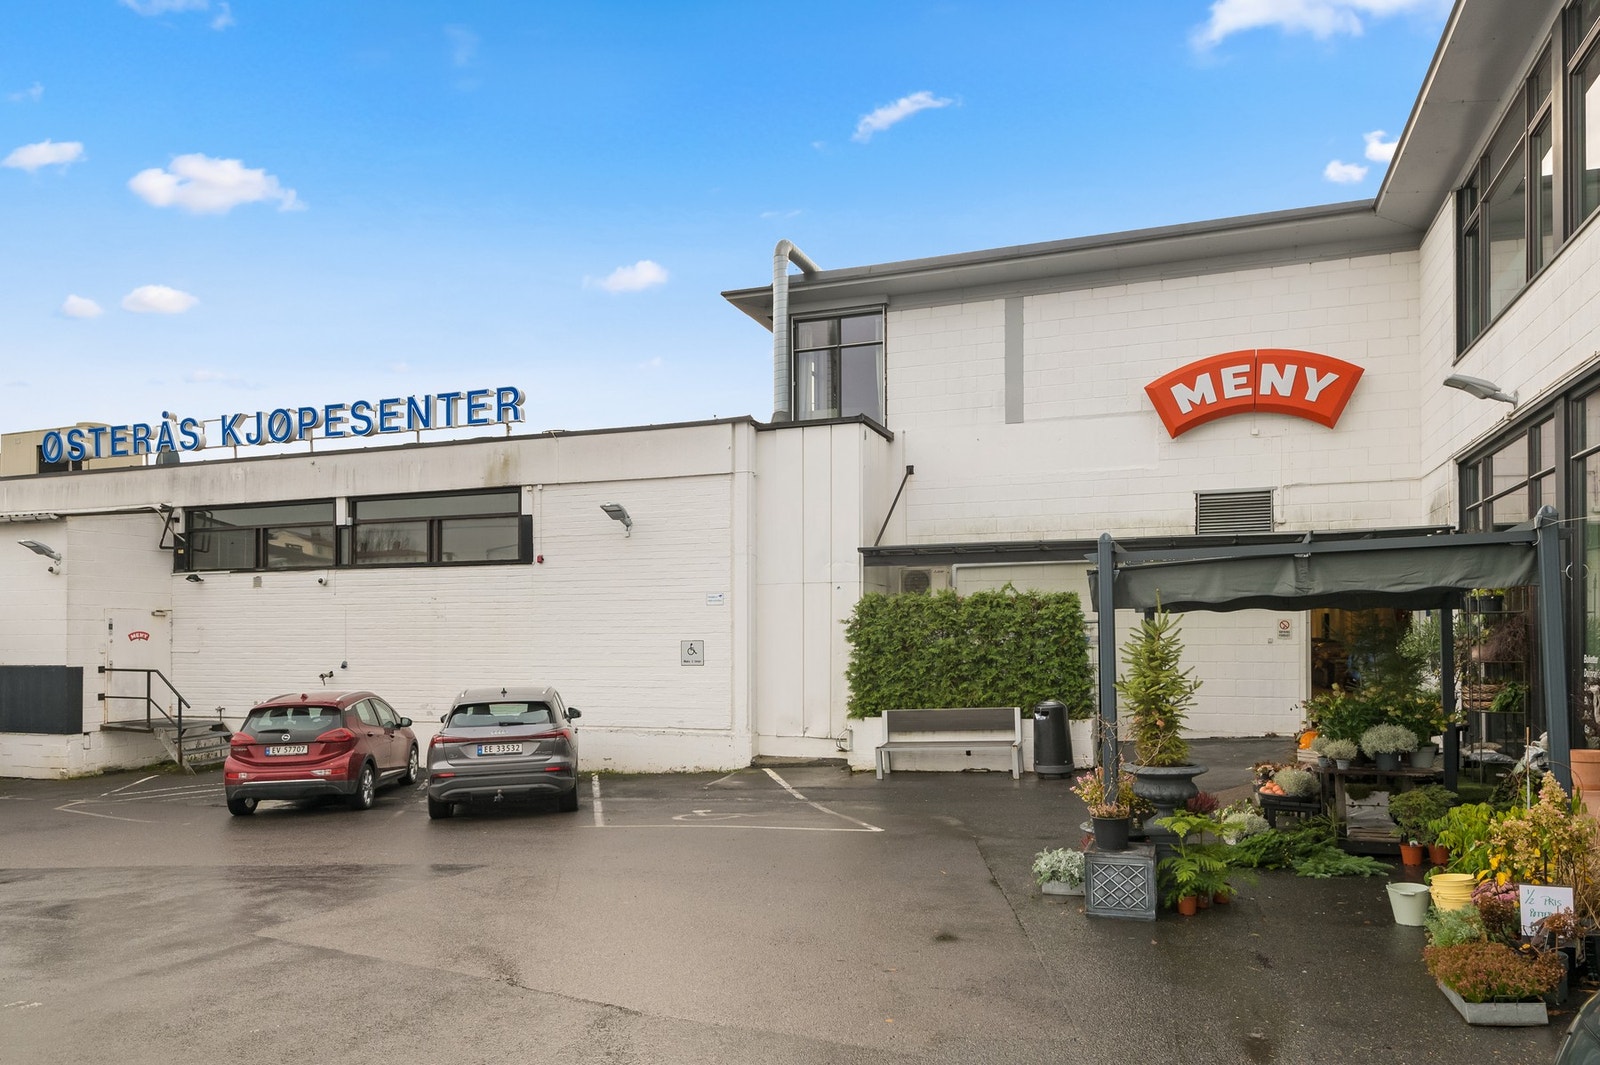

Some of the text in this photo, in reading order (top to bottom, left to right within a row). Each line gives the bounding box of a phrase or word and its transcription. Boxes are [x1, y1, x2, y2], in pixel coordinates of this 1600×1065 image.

[1170, 363, 1340, 415] MENY
[42, 386, 524, 463] ØSTERÅS KJØPESENTER
[130, 632, 149, 640] MENY
[484, 744, 521, 753] EE 33532
